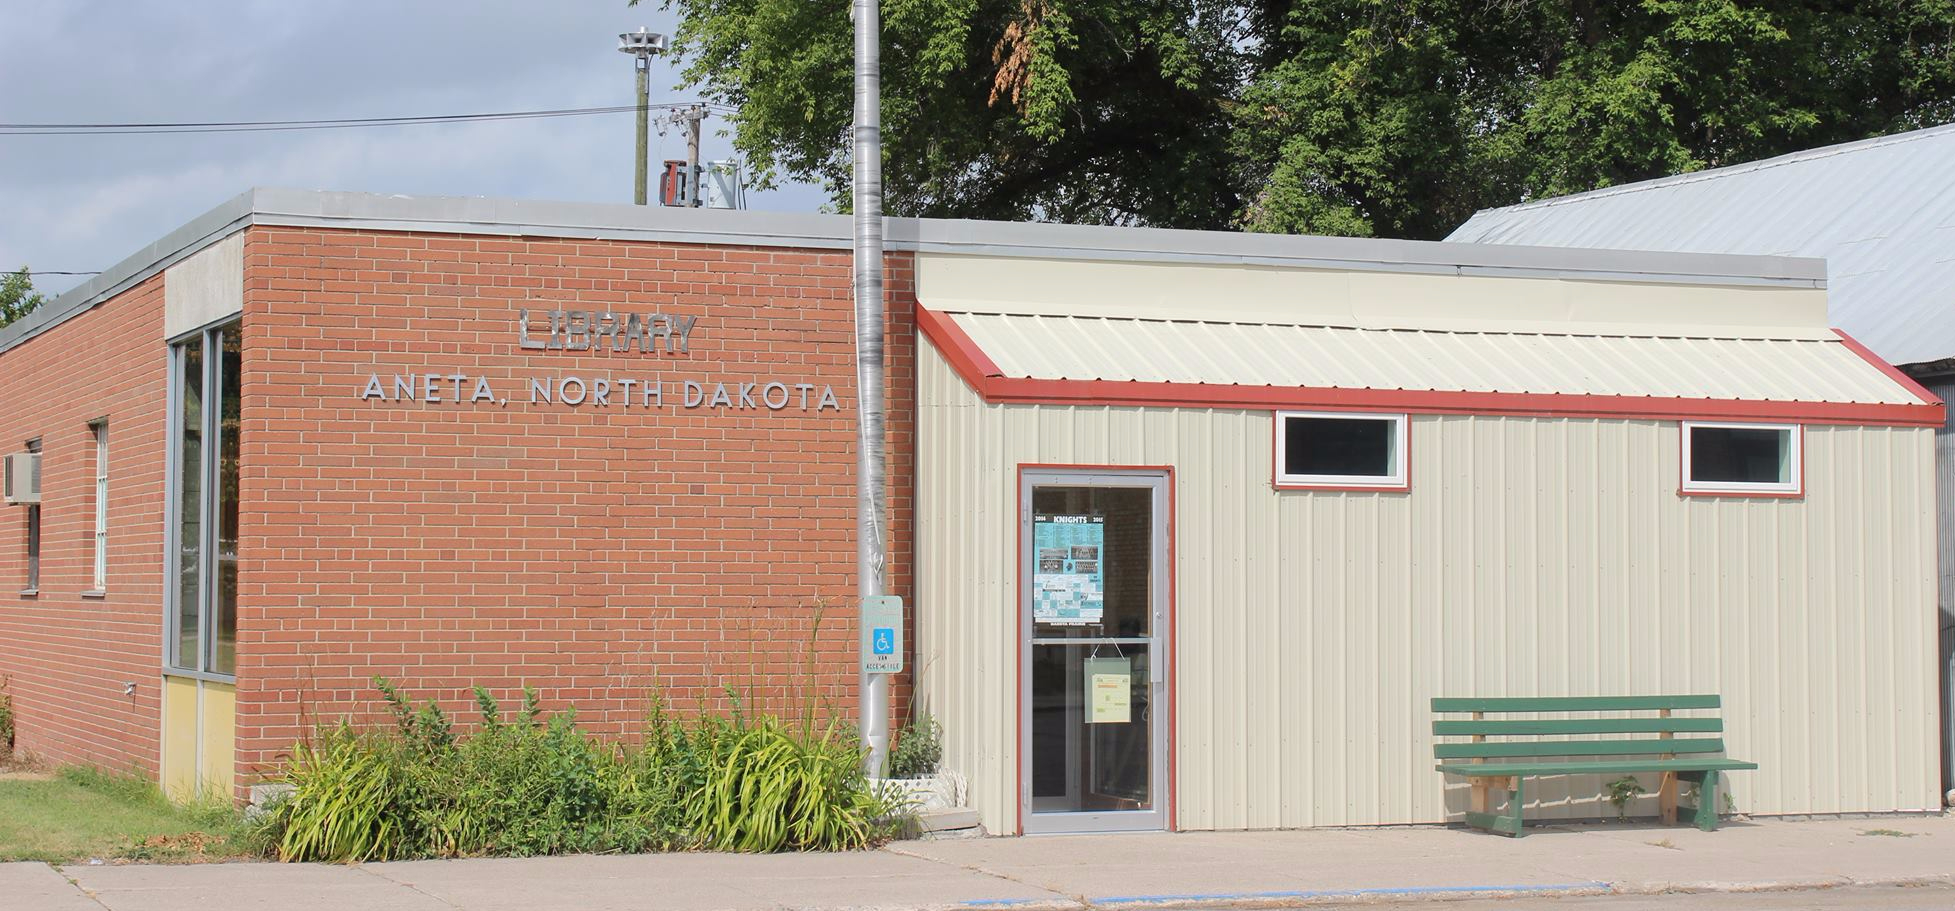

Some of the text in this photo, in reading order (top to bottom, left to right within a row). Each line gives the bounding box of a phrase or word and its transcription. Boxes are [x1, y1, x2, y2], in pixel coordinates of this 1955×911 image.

[519, 308, 697, 353] LIBRARY
[361, 373, 840, 411] ANETA, NORTH DAKOTA
